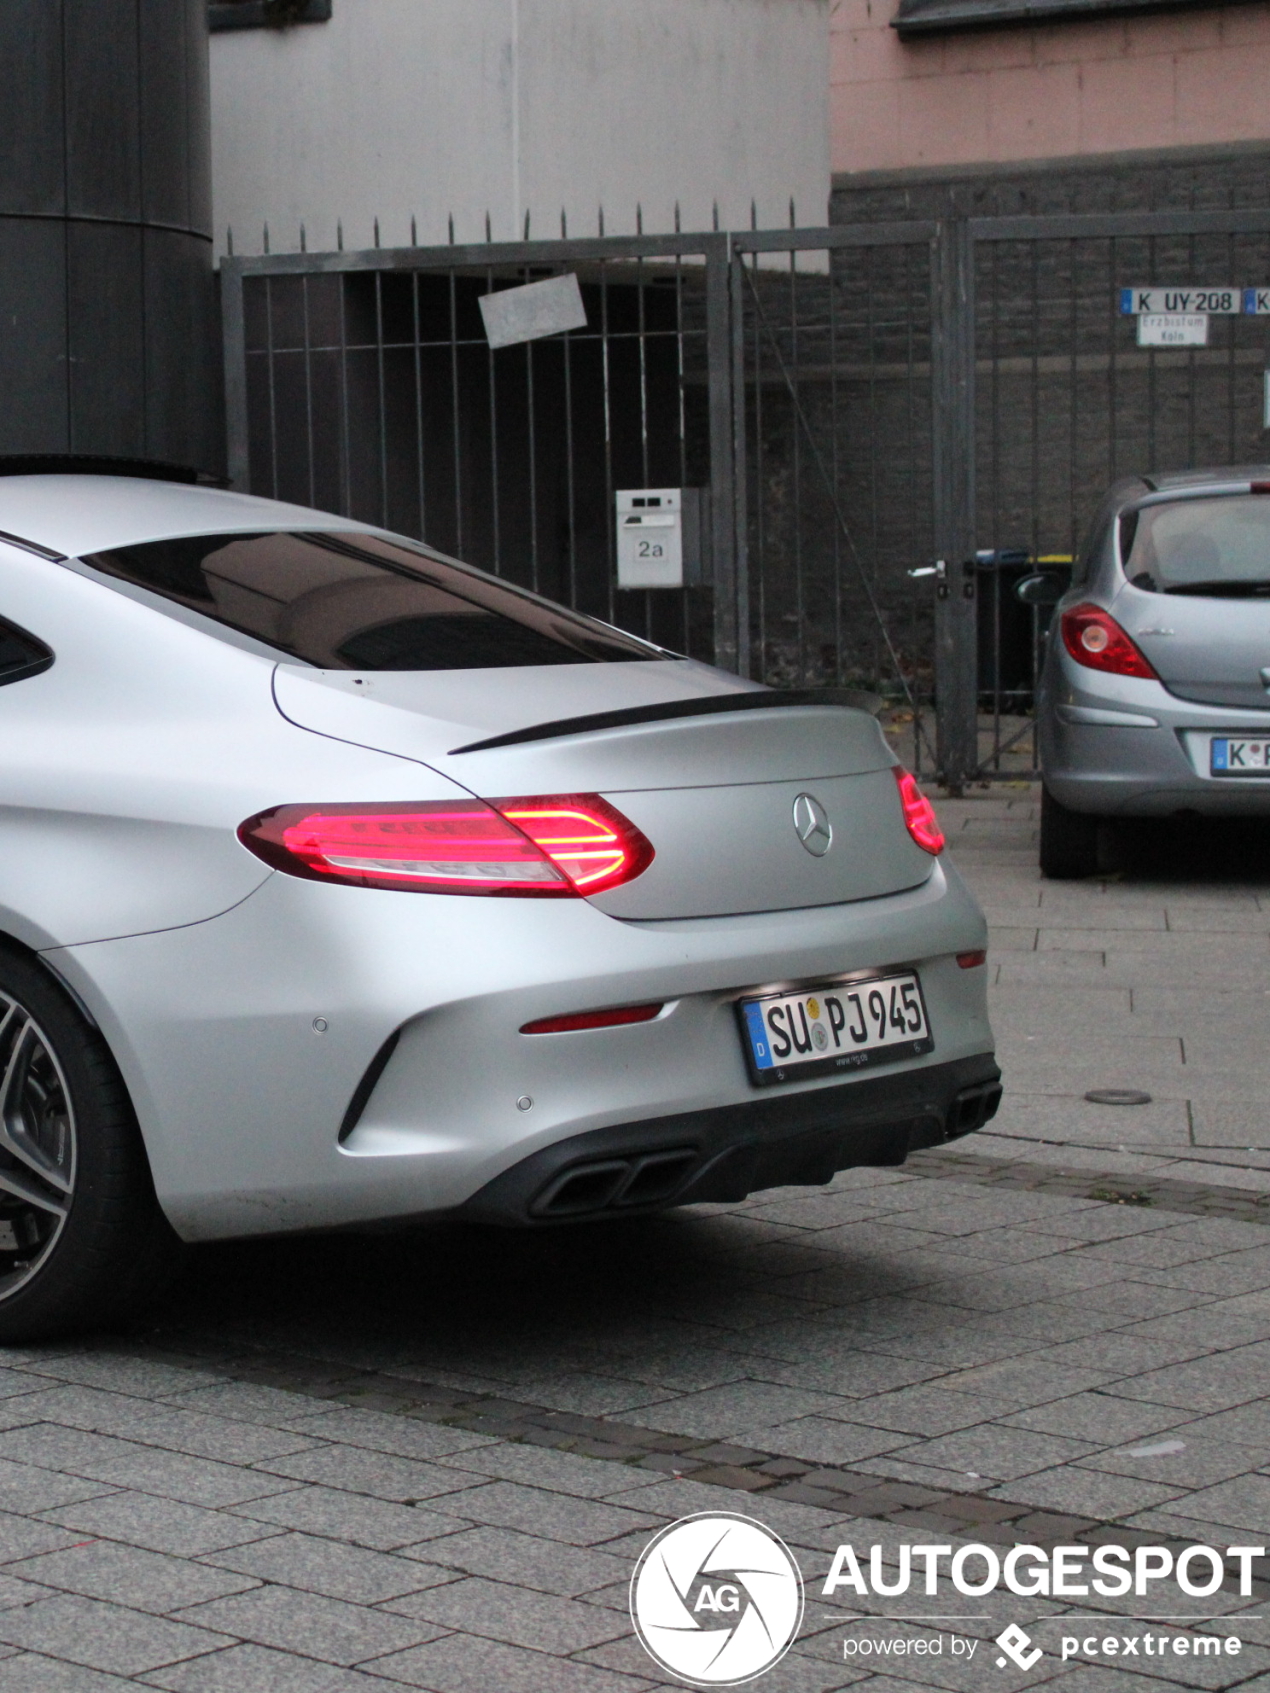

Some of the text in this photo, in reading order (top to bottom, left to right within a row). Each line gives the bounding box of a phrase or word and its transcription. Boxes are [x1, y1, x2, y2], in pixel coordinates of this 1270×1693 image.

[1138, 293, 1151, 311] K
[639, 541, 663, 557] 2a
[1230, 743, 1245, 766] K
[767, 1002, 813, 1058] SU
[756, 1042, 765, 1057] D
